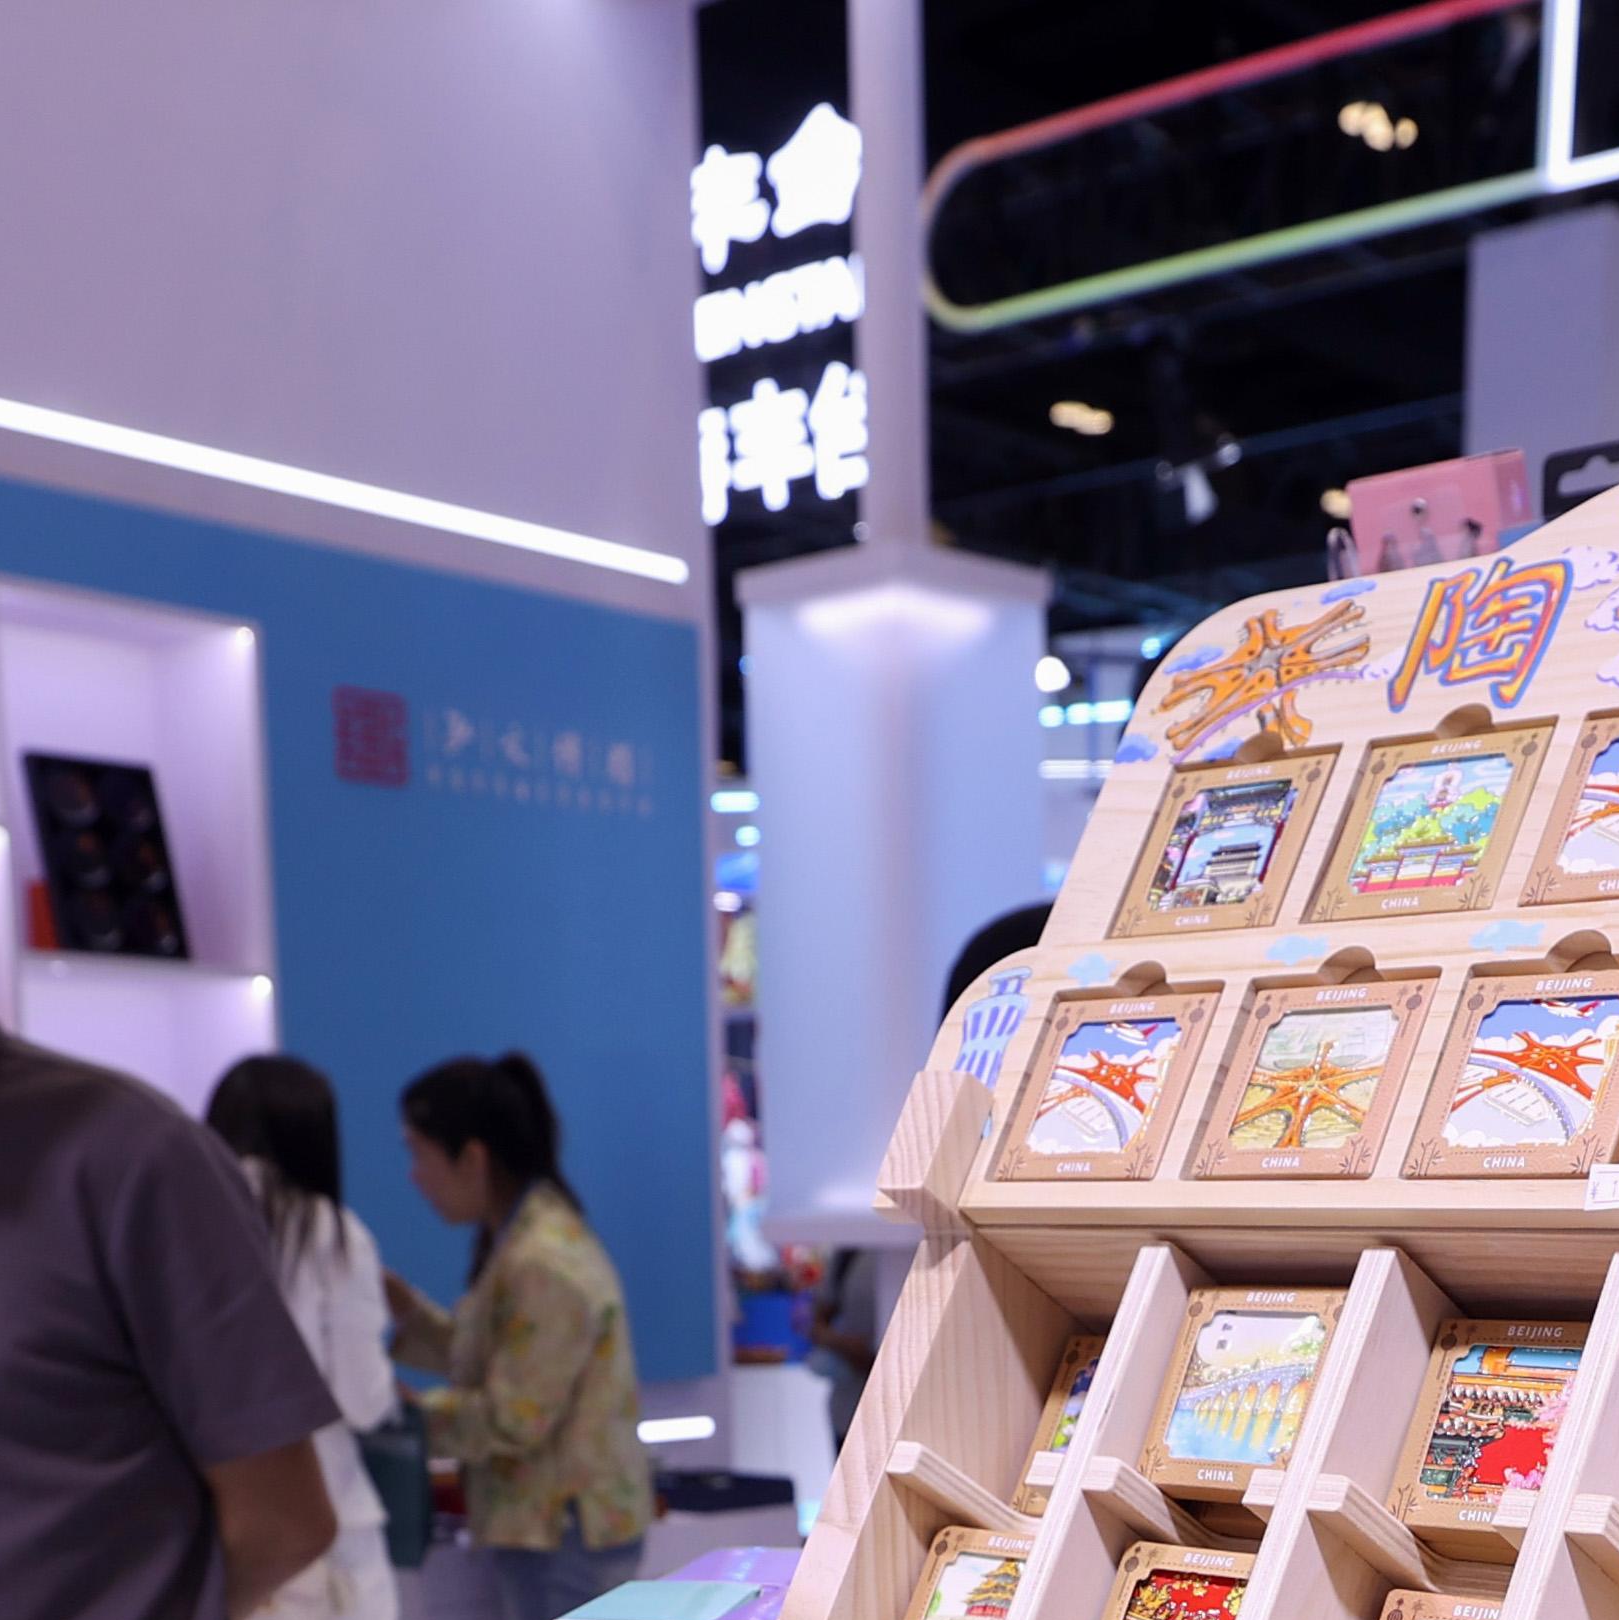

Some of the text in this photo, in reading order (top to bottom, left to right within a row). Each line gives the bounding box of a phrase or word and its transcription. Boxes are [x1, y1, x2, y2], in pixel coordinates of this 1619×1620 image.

[1431, 739, 1484, 754] BEIJING
[1225, 764, 1272, 781] BEIJING
[1380, 895, 1420, 910] CHINA
[1174, 913, 1211, 926] CHINA
[1534, 977, 1594, 993] BEIJING
[1315, 986, 1368, 1002] BEIJING
[1109, 1001, 1156, 1015] BEIJING
[1055, 1161, 1092, 1175] CHINA
[1261, 1155, 1301, 1169] CHINA
[1482, 1155, 1527, 1169] CHINA
[1246, 1291, 1297, 1303] BEIJING
[1507, 1325, 1565, 1338] BEIJING
[1196, 1468, 1235, 1483] CHINA
[1458, 1508, 1493, 1523] CHIN
[1183, 1551, 1234, 1568] BEIJING
[1453, 1604, 1500, 1620] BEIJIN
